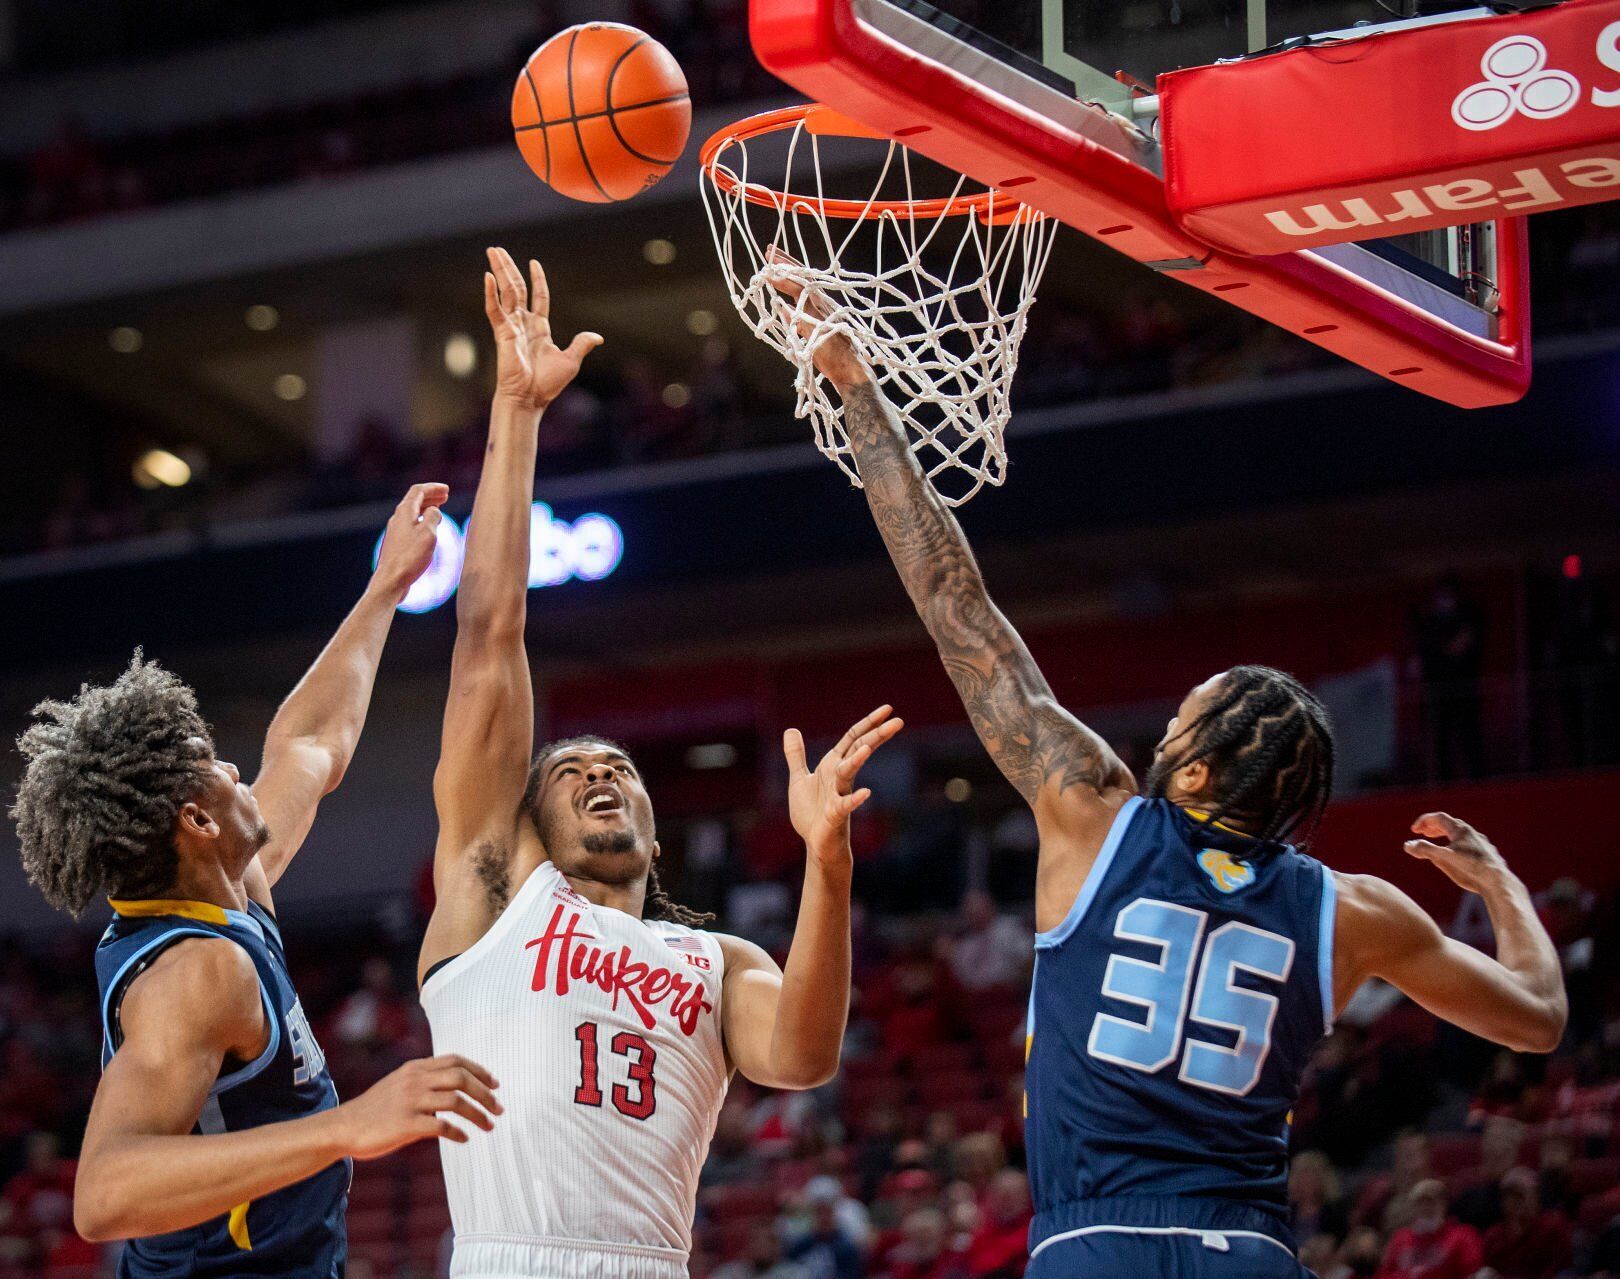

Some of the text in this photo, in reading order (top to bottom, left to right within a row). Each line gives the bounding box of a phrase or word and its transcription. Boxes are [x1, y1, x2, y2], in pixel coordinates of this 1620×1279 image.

[1264, 168, 1564, 236] Farm
[525, 904, 712, 1036] Huskers
[1087, 897, 1296, 1097] 35
[574, 1021, 656, 1121] 13
